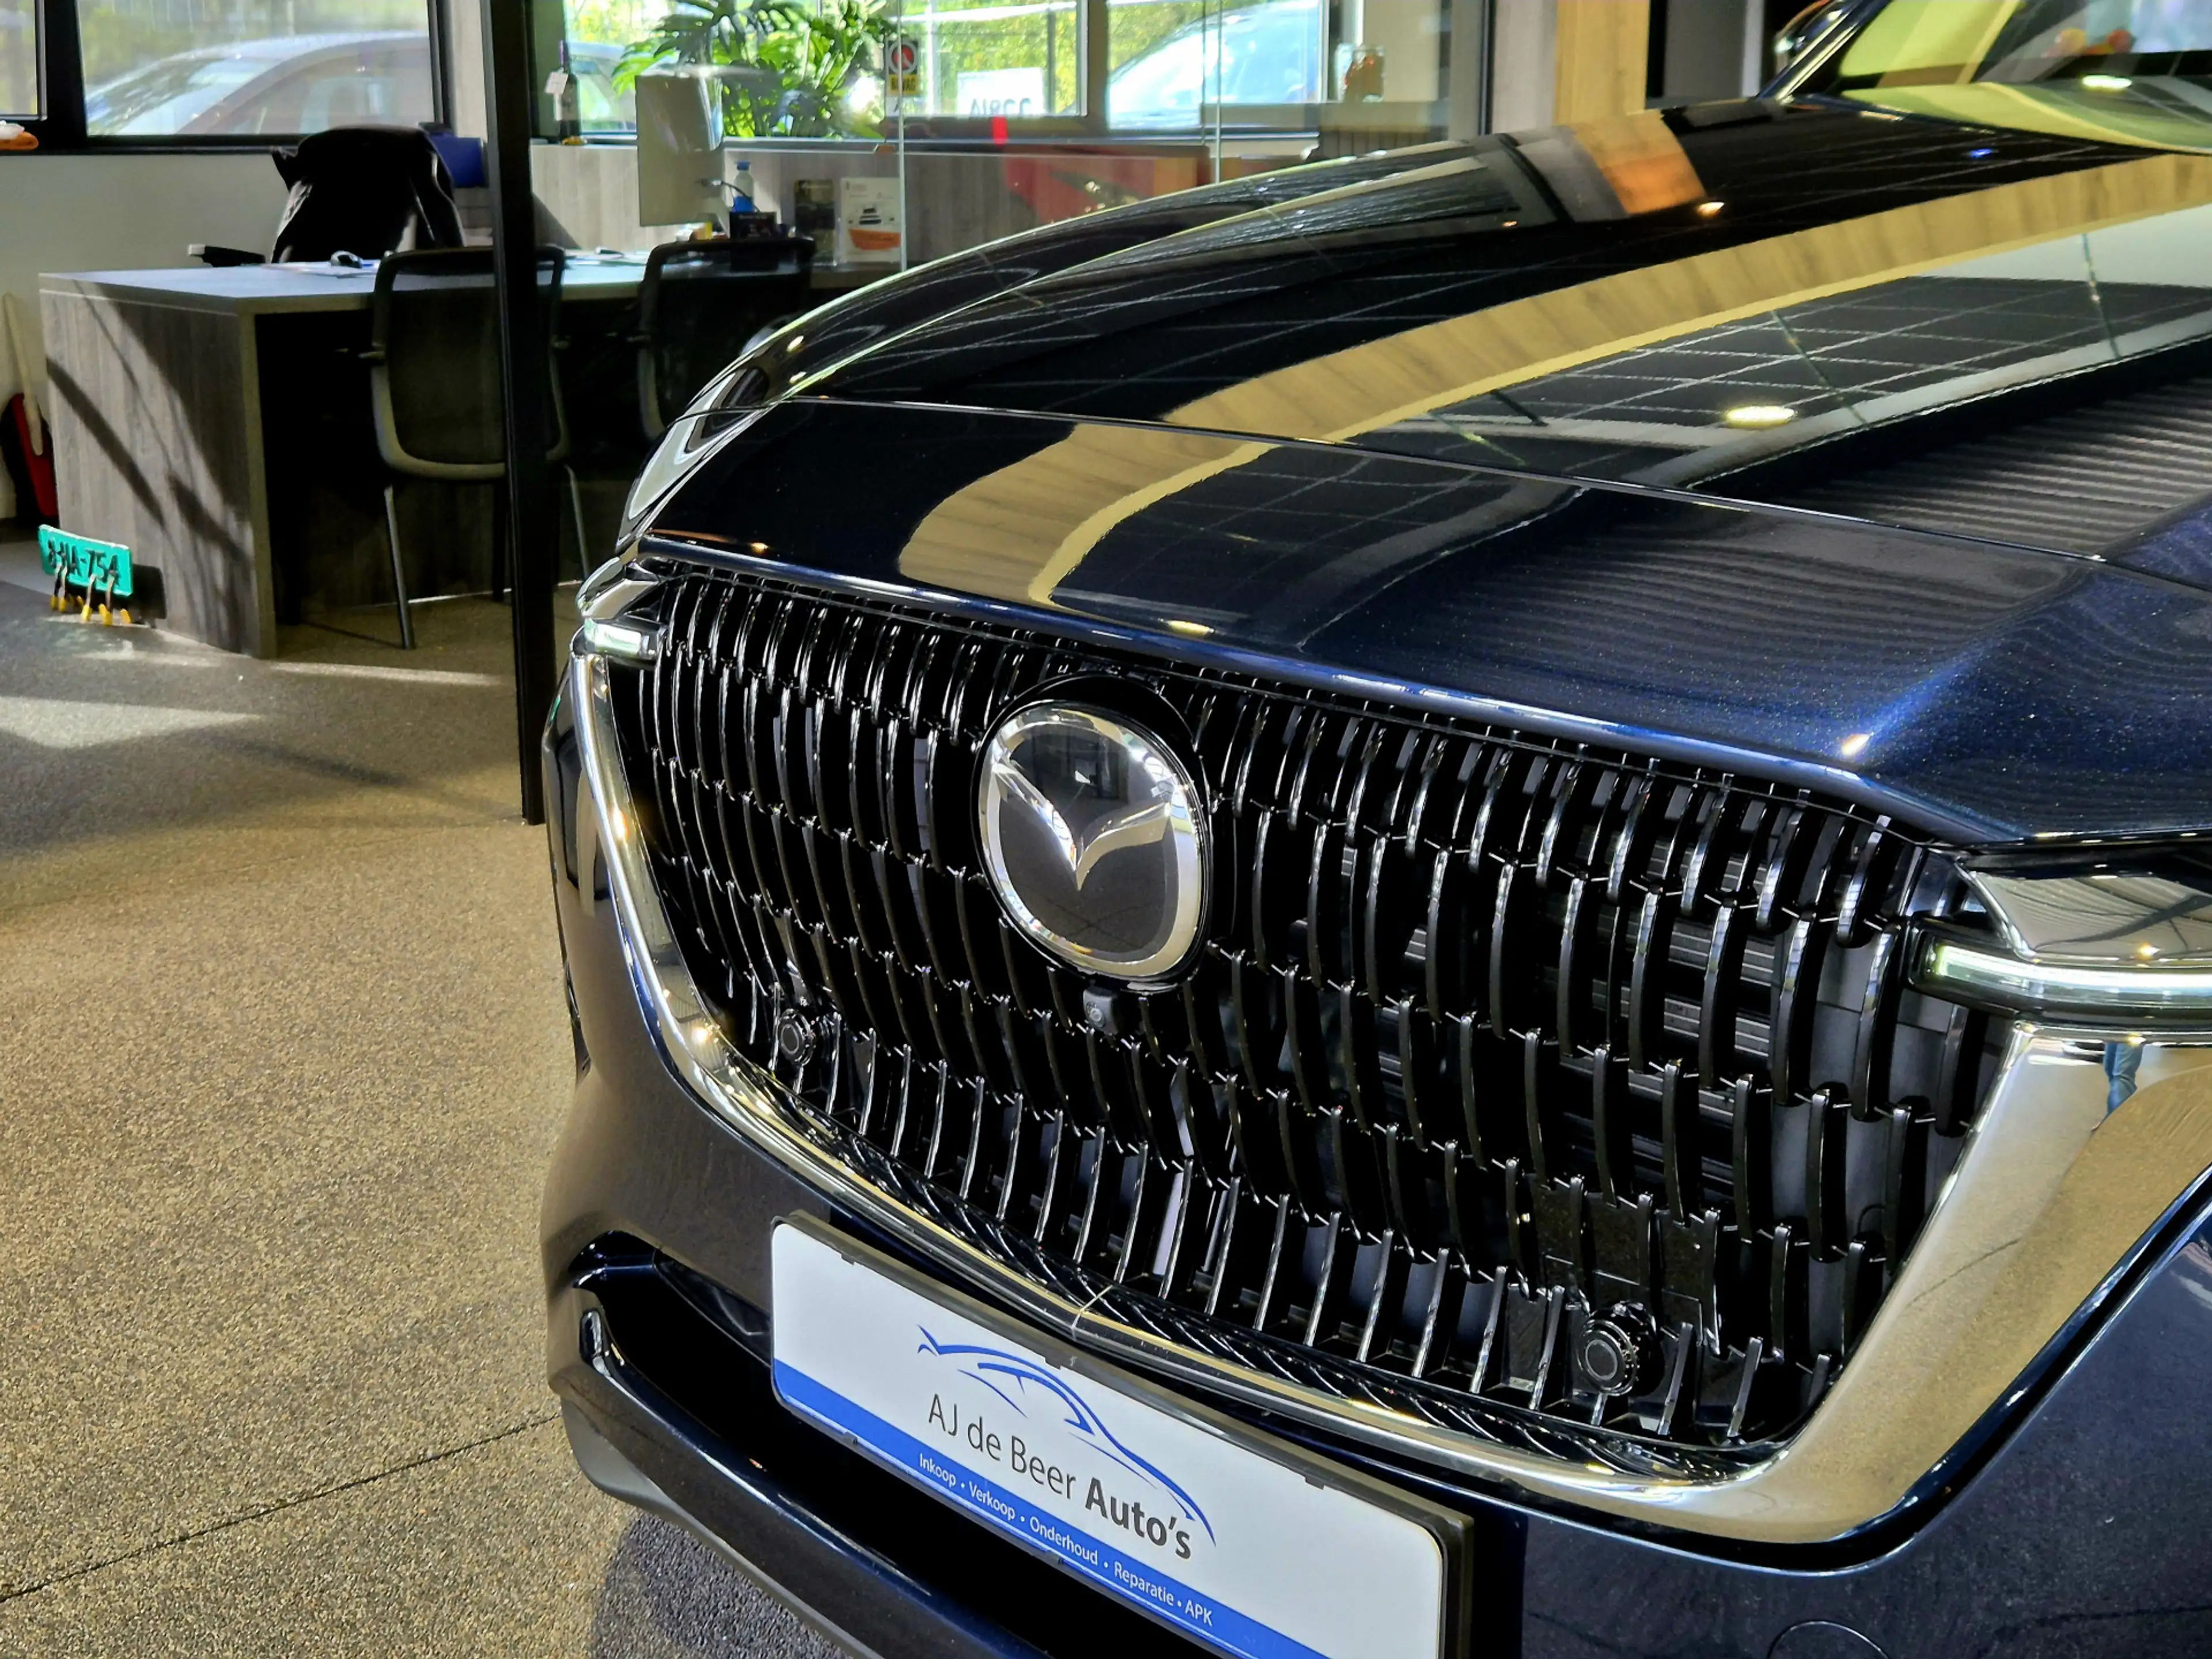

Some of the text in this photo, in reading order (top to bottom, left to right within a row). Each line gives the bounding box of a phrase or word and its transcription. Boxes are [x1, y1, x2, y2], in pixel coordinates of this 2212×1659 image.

[919, 1453, 1213, 1627] Inkoop Verkoop Onderhoud Reparatie APK
[928, 1393, 1192, 1559] AJ de Beer Auto's
